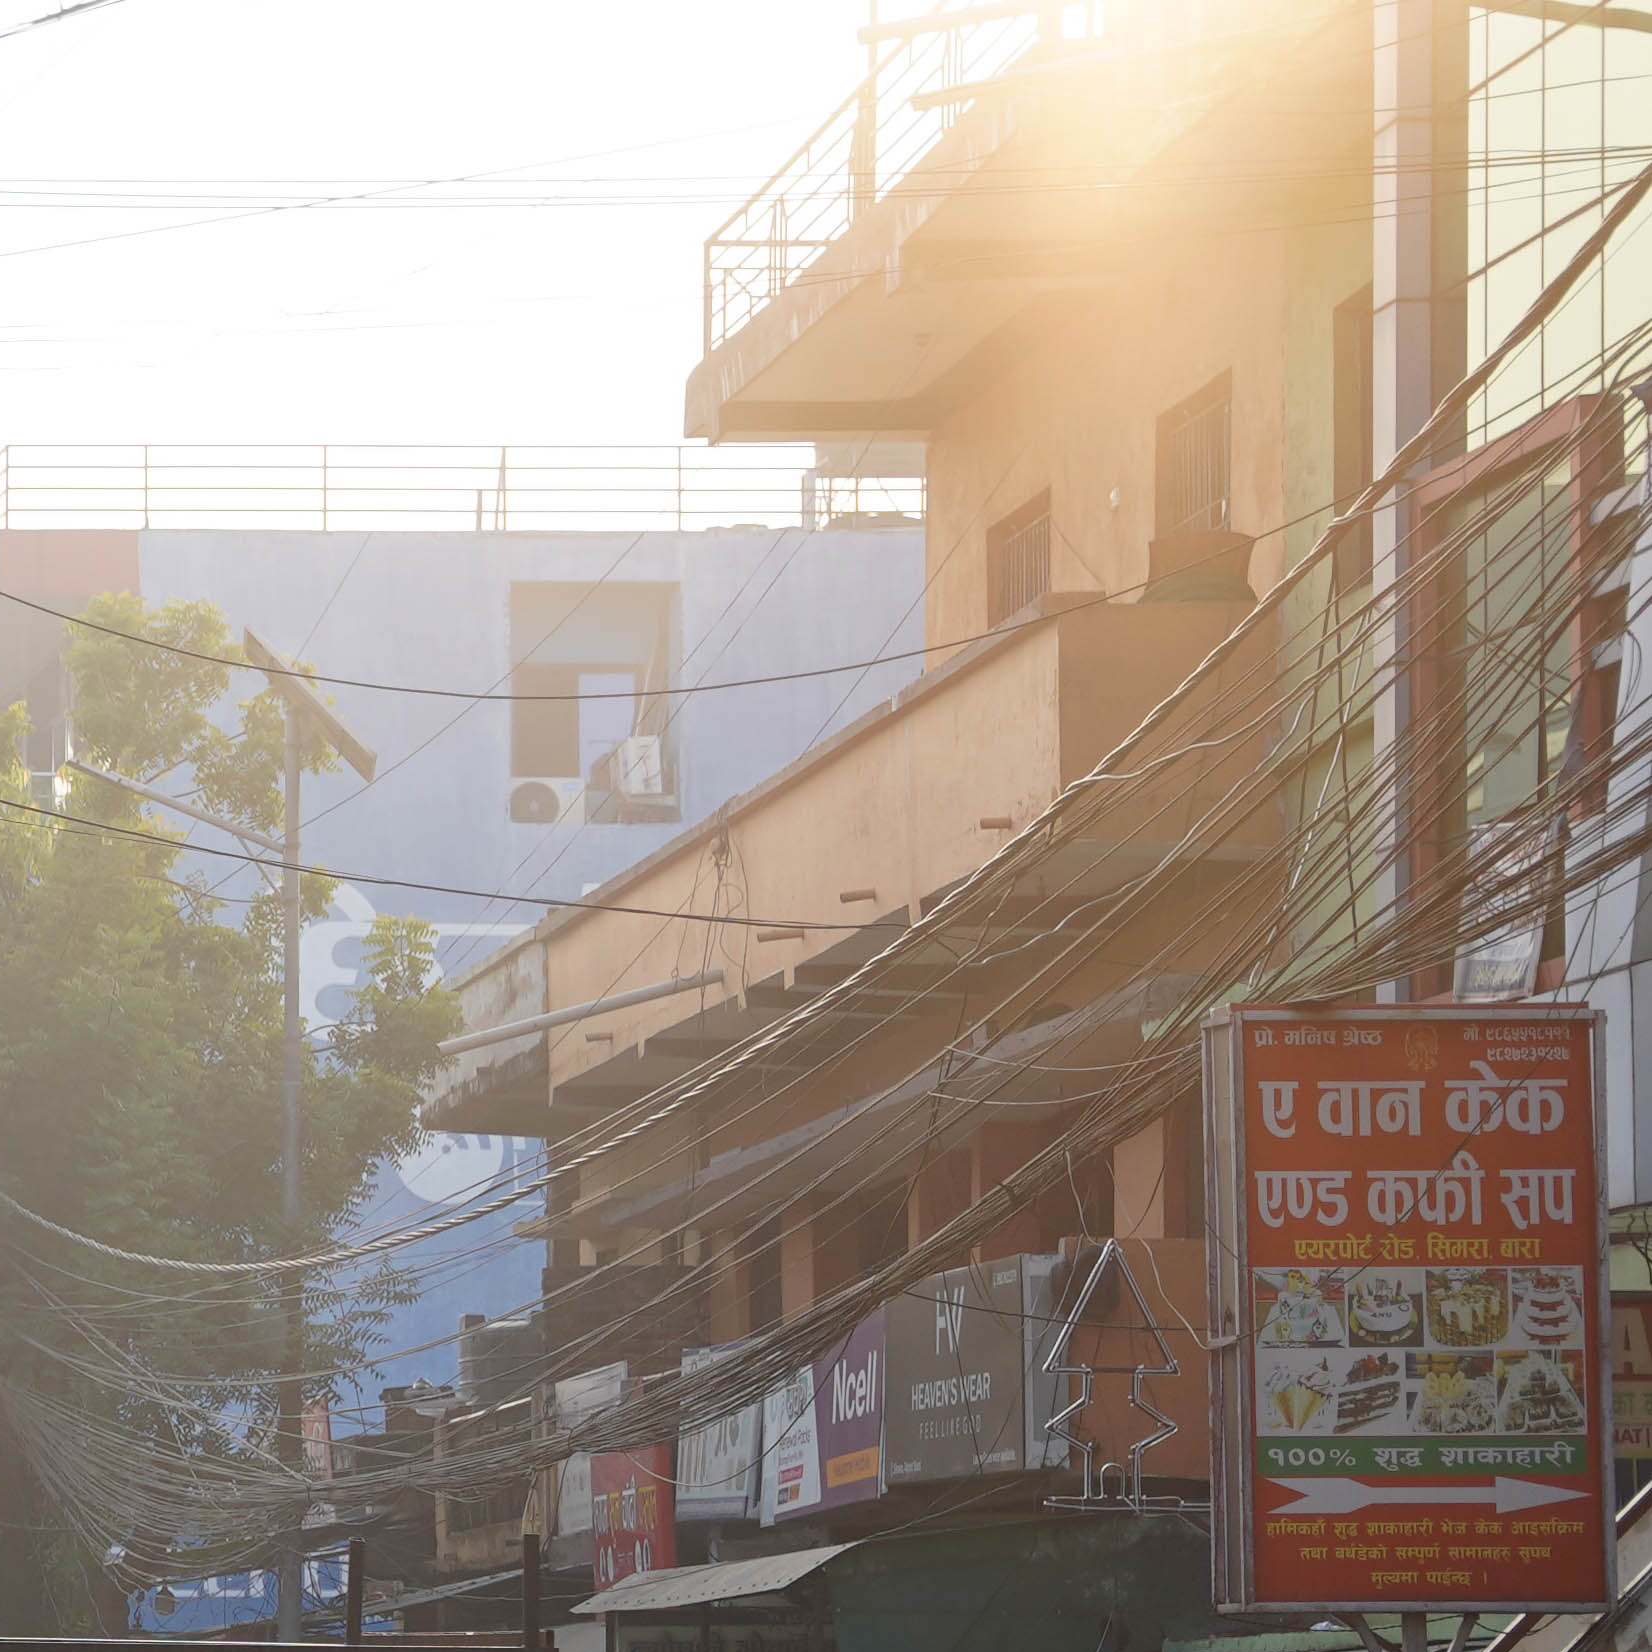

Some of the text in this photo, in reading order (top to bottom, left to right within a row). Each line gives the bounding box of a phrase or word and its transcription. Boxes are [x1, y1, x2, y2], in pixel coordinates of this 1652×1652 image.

[1258, 1060, 1569, 1138] ए वान केक
[1255, 1150, 1576, 1229] एण्ड कफी सप
[1293, 1232, 1374, 1260] एयरपोर्ट
[1500, 1237, 1542, 1260] बारा
[832, 1350, 878, 1425] Ncell
[911, 1371, 992, 1412] HEAVEN'S WEAR
[1439, 1441, 1576, 1468] शाकाहारी
